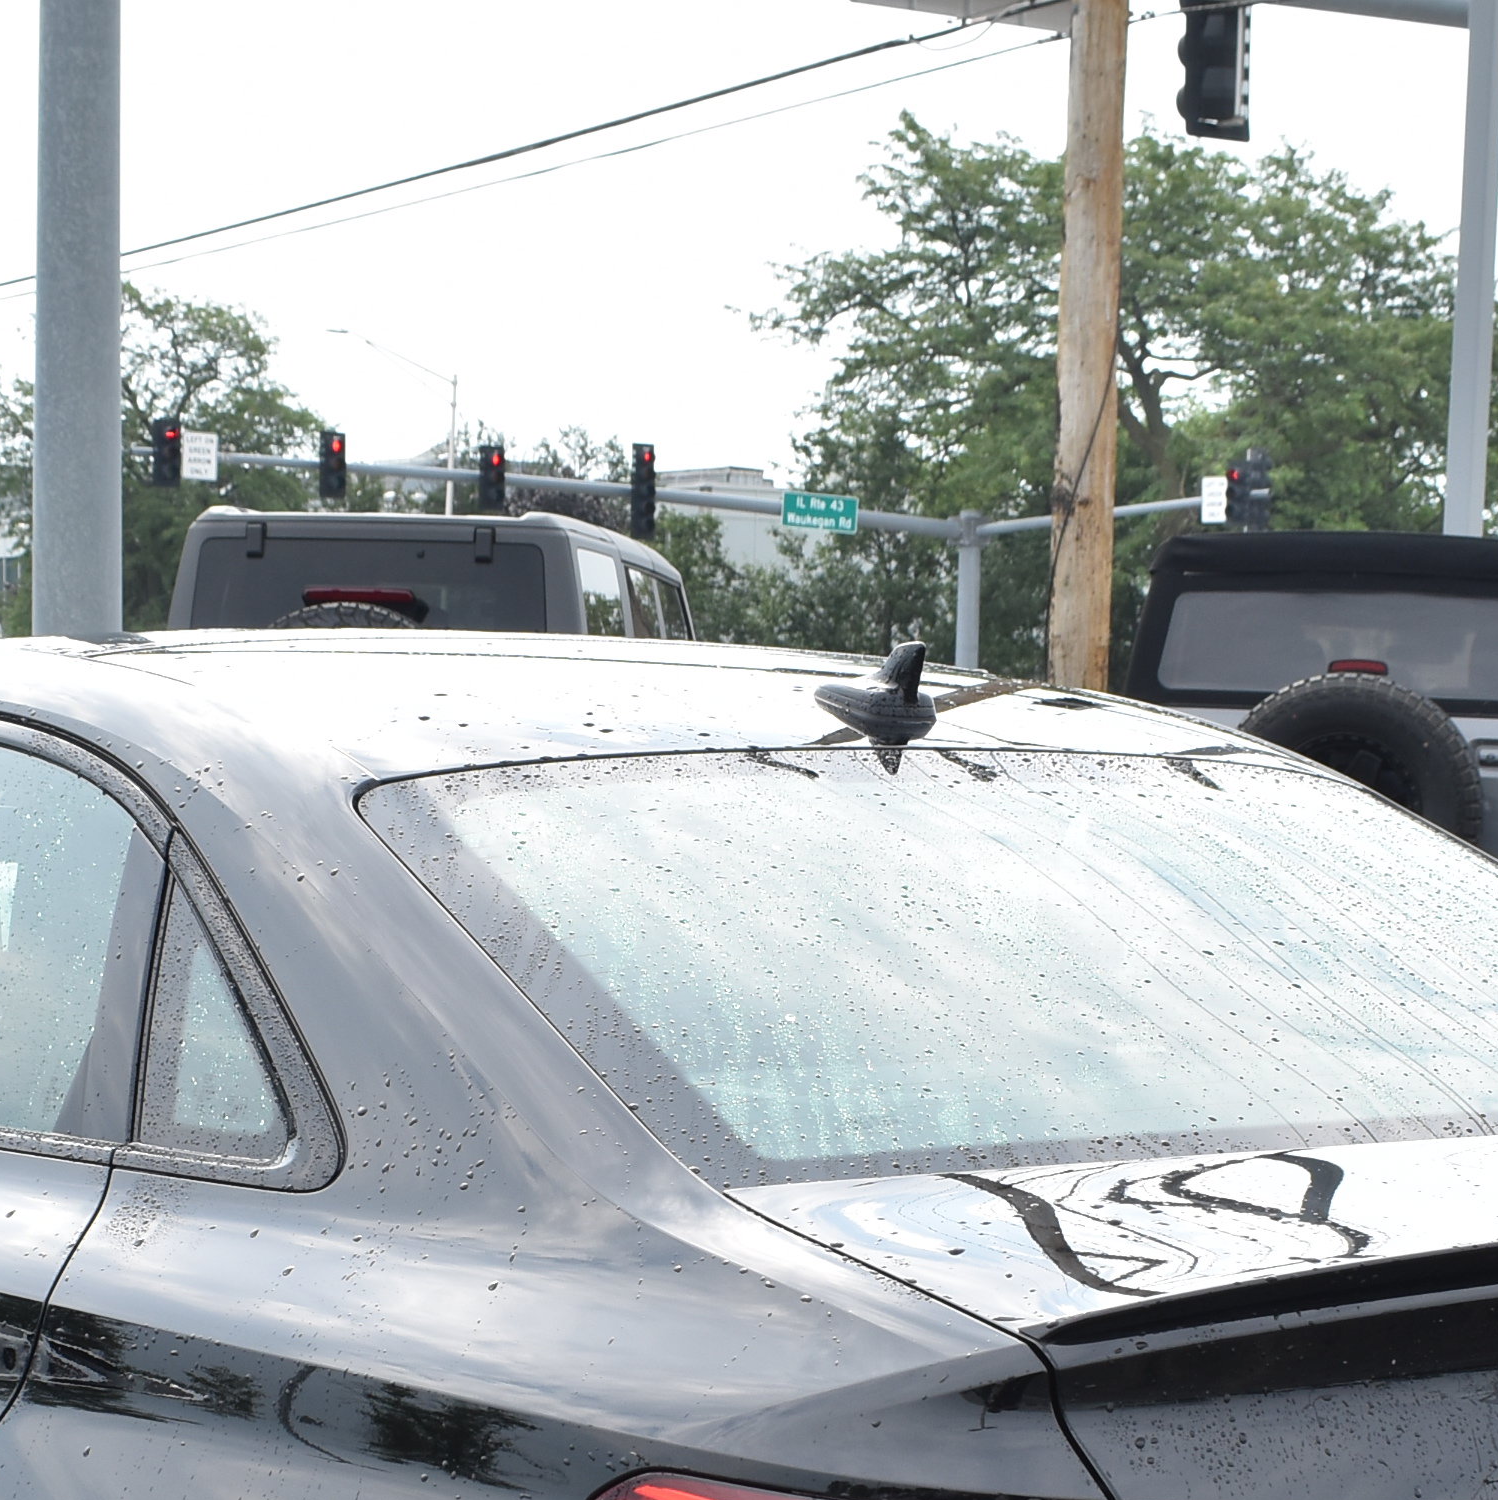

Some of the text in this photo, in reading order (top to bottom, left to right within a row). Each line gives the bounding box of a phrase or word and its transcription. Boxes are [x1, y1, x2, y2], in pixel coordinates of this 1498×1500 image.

[796, 495, 806, 509] IL
[830, 499, 845, 513] 43
[839, 515, 853, 530] Rd
